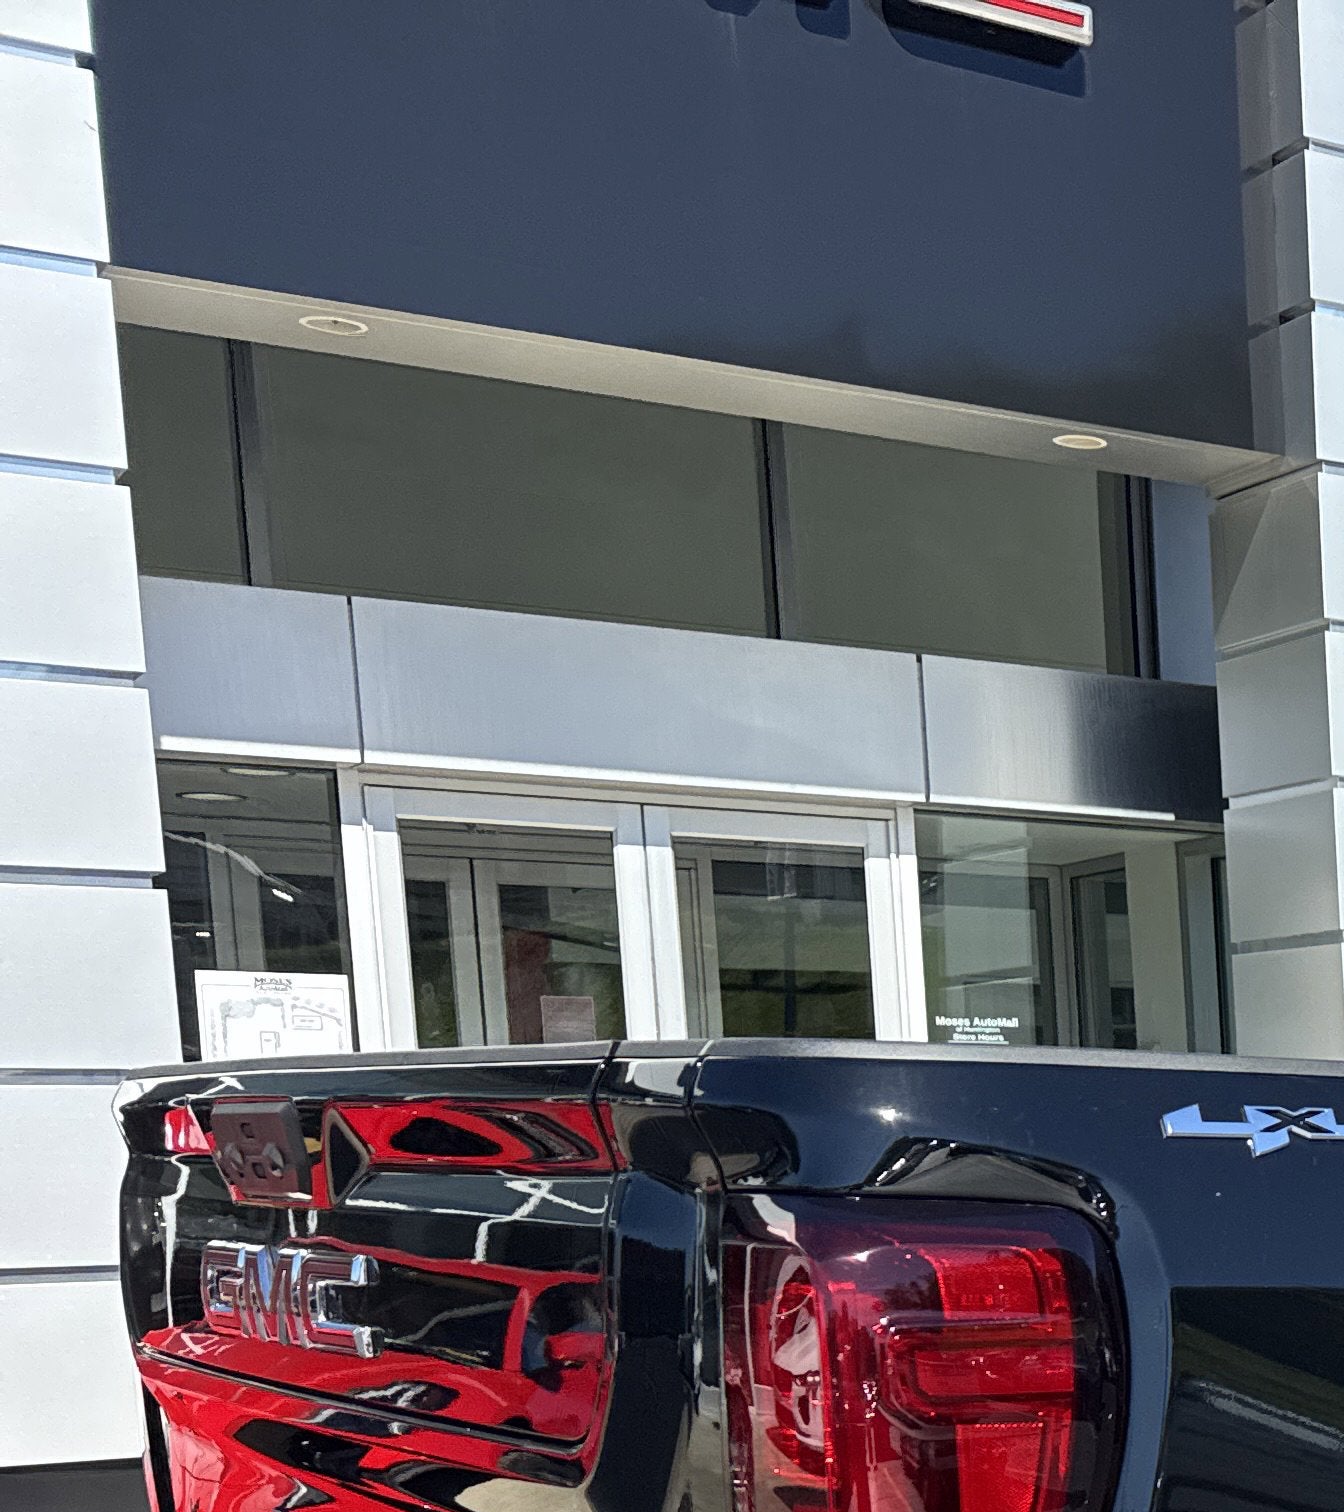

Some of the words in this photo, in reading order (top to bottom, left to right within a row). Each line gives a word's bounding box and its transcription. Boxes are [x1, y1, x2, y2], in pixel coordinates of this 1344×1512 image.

[935, 1015, 970, 1027] Moses
[972, 1016, 1019, 1028] AutoMall
[952, 1032, 976, 1041] Store
[977, 1033, 1005, 1041] Hours
[200, 1239, 386, 1359] GMC
